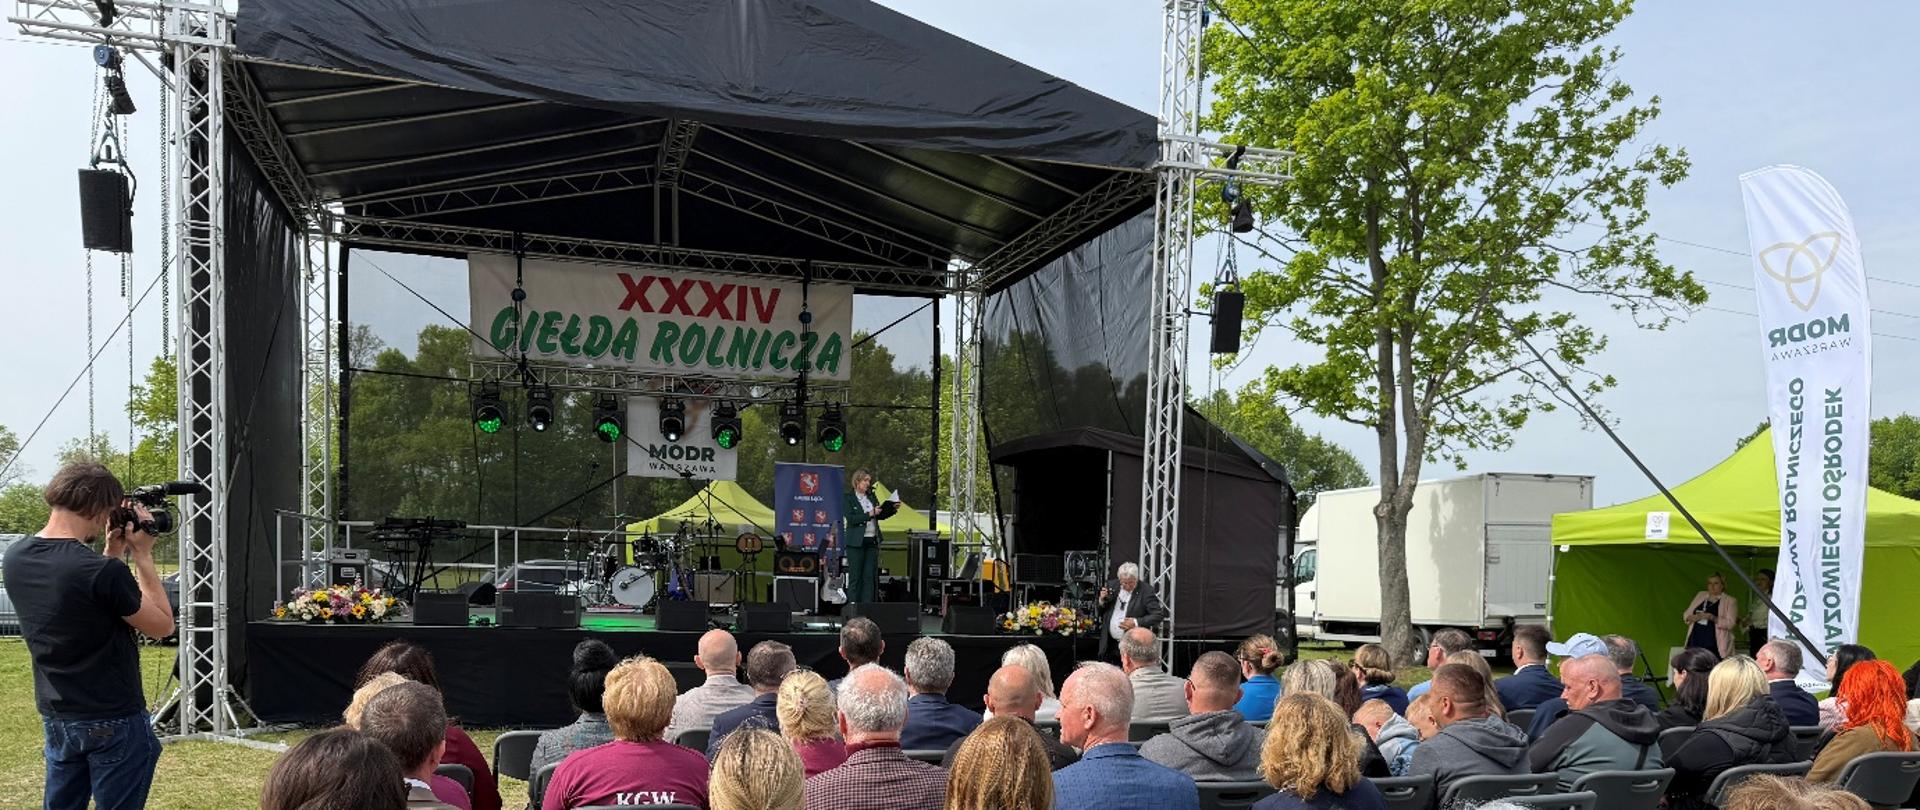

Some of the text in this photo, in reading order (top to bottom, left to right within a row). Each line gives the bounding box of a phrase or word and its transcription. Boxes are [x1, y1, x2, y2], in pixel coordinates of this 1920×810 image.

[617, 272, 781, 324] XXXIV
[489, 306, 843, 375] GIEŁDA ROLNICZA
[649, 443, 715, 463] MODR
[649, 462, 716, 474] WARSZAWA
[616, 791, 676, 805] KGW
